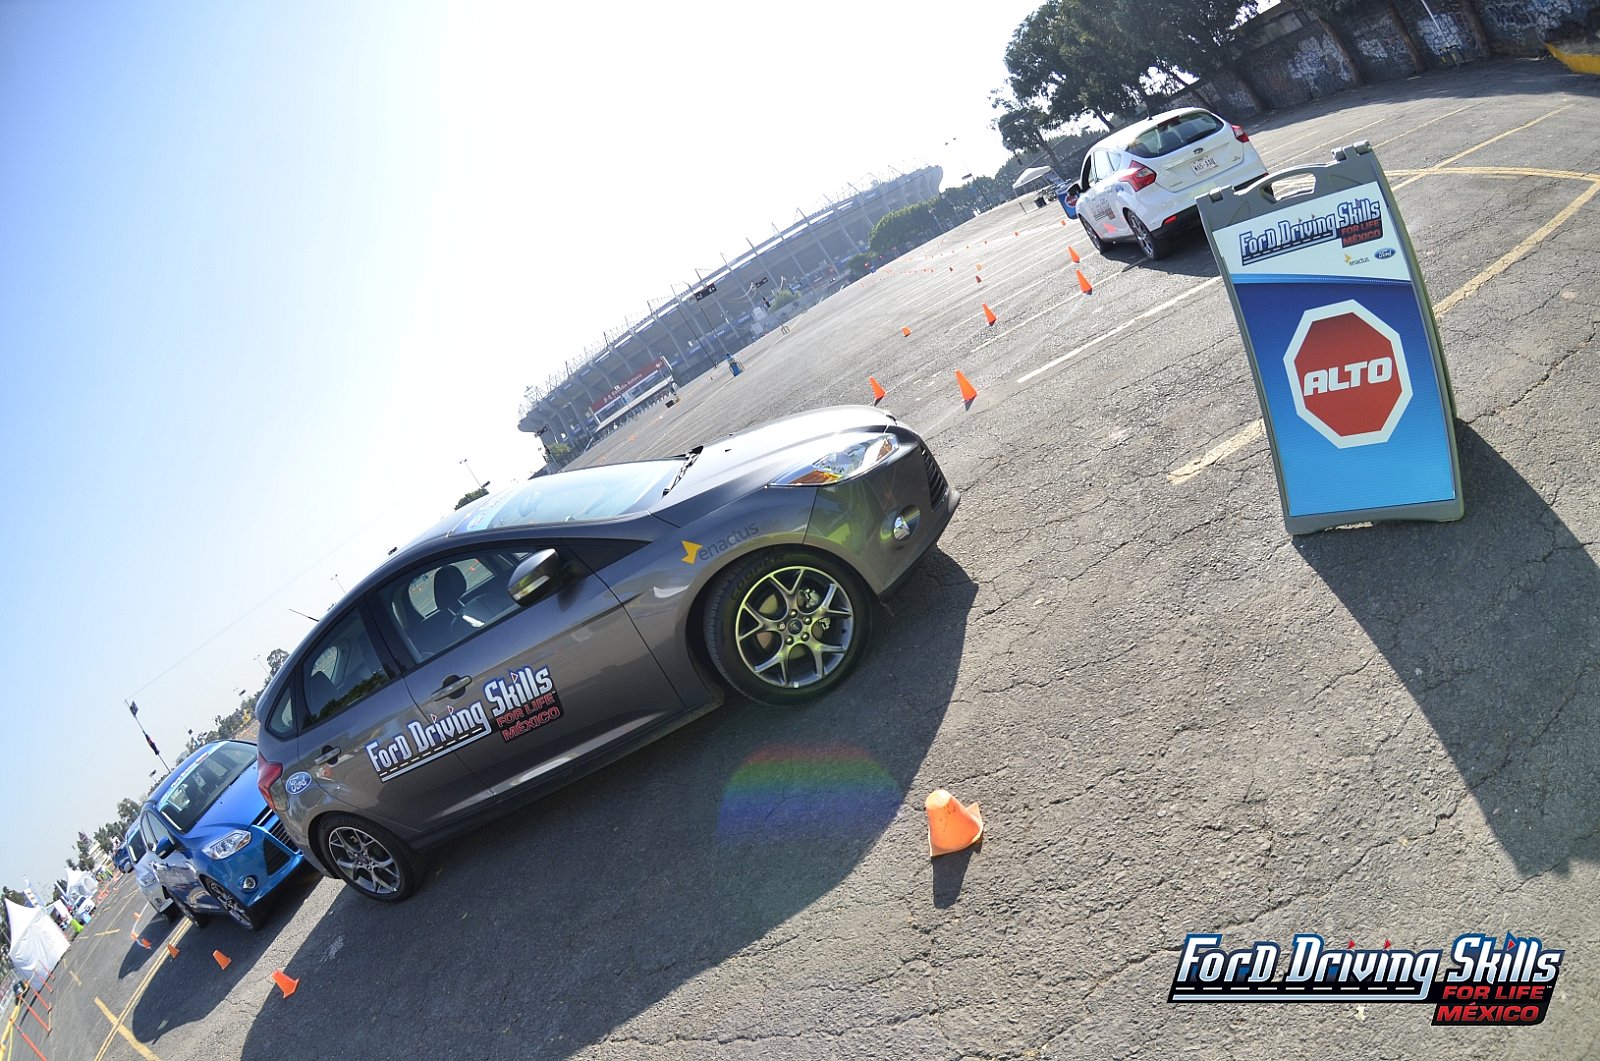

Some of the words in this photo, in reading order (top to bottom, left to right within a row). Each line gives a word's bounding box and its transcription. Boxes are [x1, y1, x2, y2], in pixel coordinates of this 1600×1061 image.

[1278, 213, 1337, 247] Driving
[1338, 199, 1381, 228] Skills
[1342, 224, 1359, 234] FOR
[1360, 219, 1380, 230] LIFE
[1349, 256, 1370, 266] enactus
[1377, 248, 1395, 259] Ford
[1303, 356, 1393, 397] ALTO
[699, 522, 760, 561] enactus
[407, 701, 492, 752] Driving
[483, 667, 554, 718] Skills
[496, 707, 525, 728] FOR
[524, 693, 556, 715] LIFE
[501, 706, 561, 741] MÉXICO
[288, 774, 309, 793] Ford
